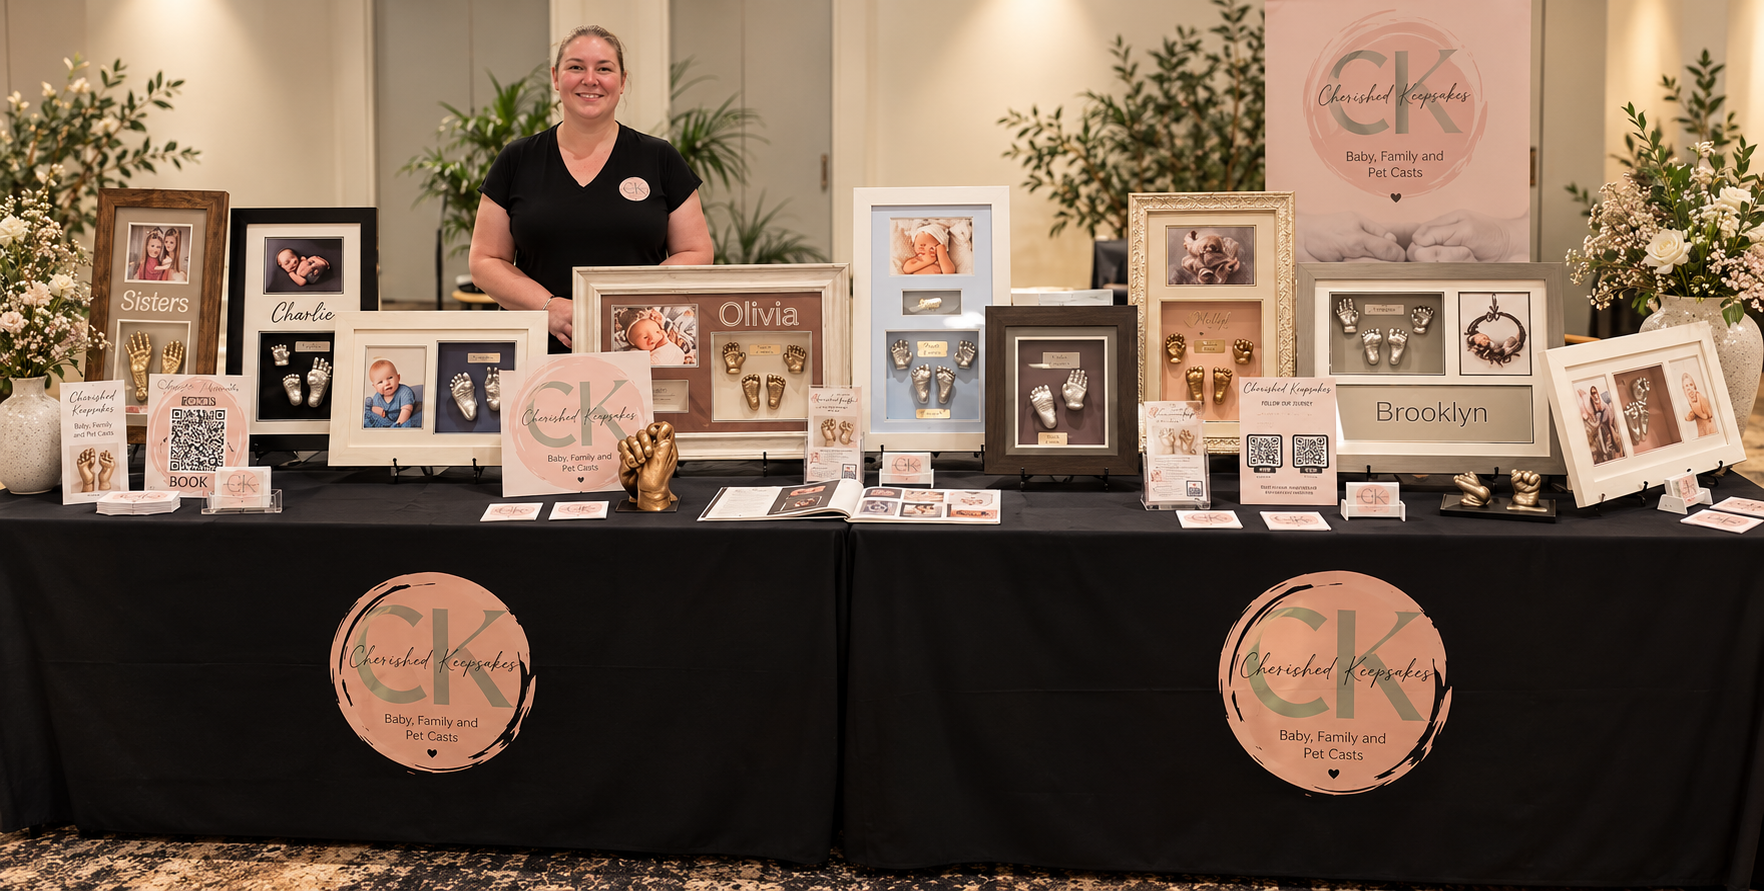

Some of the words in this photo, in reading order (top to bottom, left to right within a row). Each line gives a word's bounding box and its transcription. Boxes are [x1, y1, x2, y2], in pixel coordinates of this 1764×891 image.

[1318, 83, 1395, 107] Cherished
[1399, 82, 1471, 110] Keepsakes
[1326, 49, 1464, 136] CK
[1346, 151, 1377, 164] Baby,
[1381, 151, 1418, 164] Family
[1422, 151, 1444, 162] and
[1368, 167, 1387, 178] Pet
[1391, 167, 1423, 178] Casts
[121, 290, 189, 313] Sisters
[271, 301, 336, 323] Charlie
[719, 301, 799, 327] Olivia
[1243, 381, 1288, 394] Cherished
[522, 407, 580, 426] Cherished
[584, 406, 636, 426] Keepsakes
[525, 379, 629, 448] CK
[1376, 400, 1489, 428] Brooklyn
[547, 454, 568, 463] Baby,
[571, 453, 595, 463] Family
[597, 452, 612, 460] and
[562, 464, 575, 472] Pet
[169, 475, 208, 488] BOOK
[349, 645, 434, 669] Cherished
[439, 648, 520, 677] Keepsakes
[354, 604, 514, 708] CK
[1245, 606, 1426, 722] CK
[1240, 652, 1338, 680] Cherished
[1344, 656, 1435, 688] Keepsakes
[385, 713, 414, 727] Baby,
[418, 715, 453, 729] Family
[457, 718, 478, 728] and
[406, 730, 424, 741] Pet
[427, 731, 458, 743] Casts
[1279, 729, 1313, 743] Baby,
[1317, 730, 1358, 745] Family
[1362, 732, 1386, 744] and
[1304, 747, 1324, 759] Pet
[1328, 748, 1363, 761] Casts
